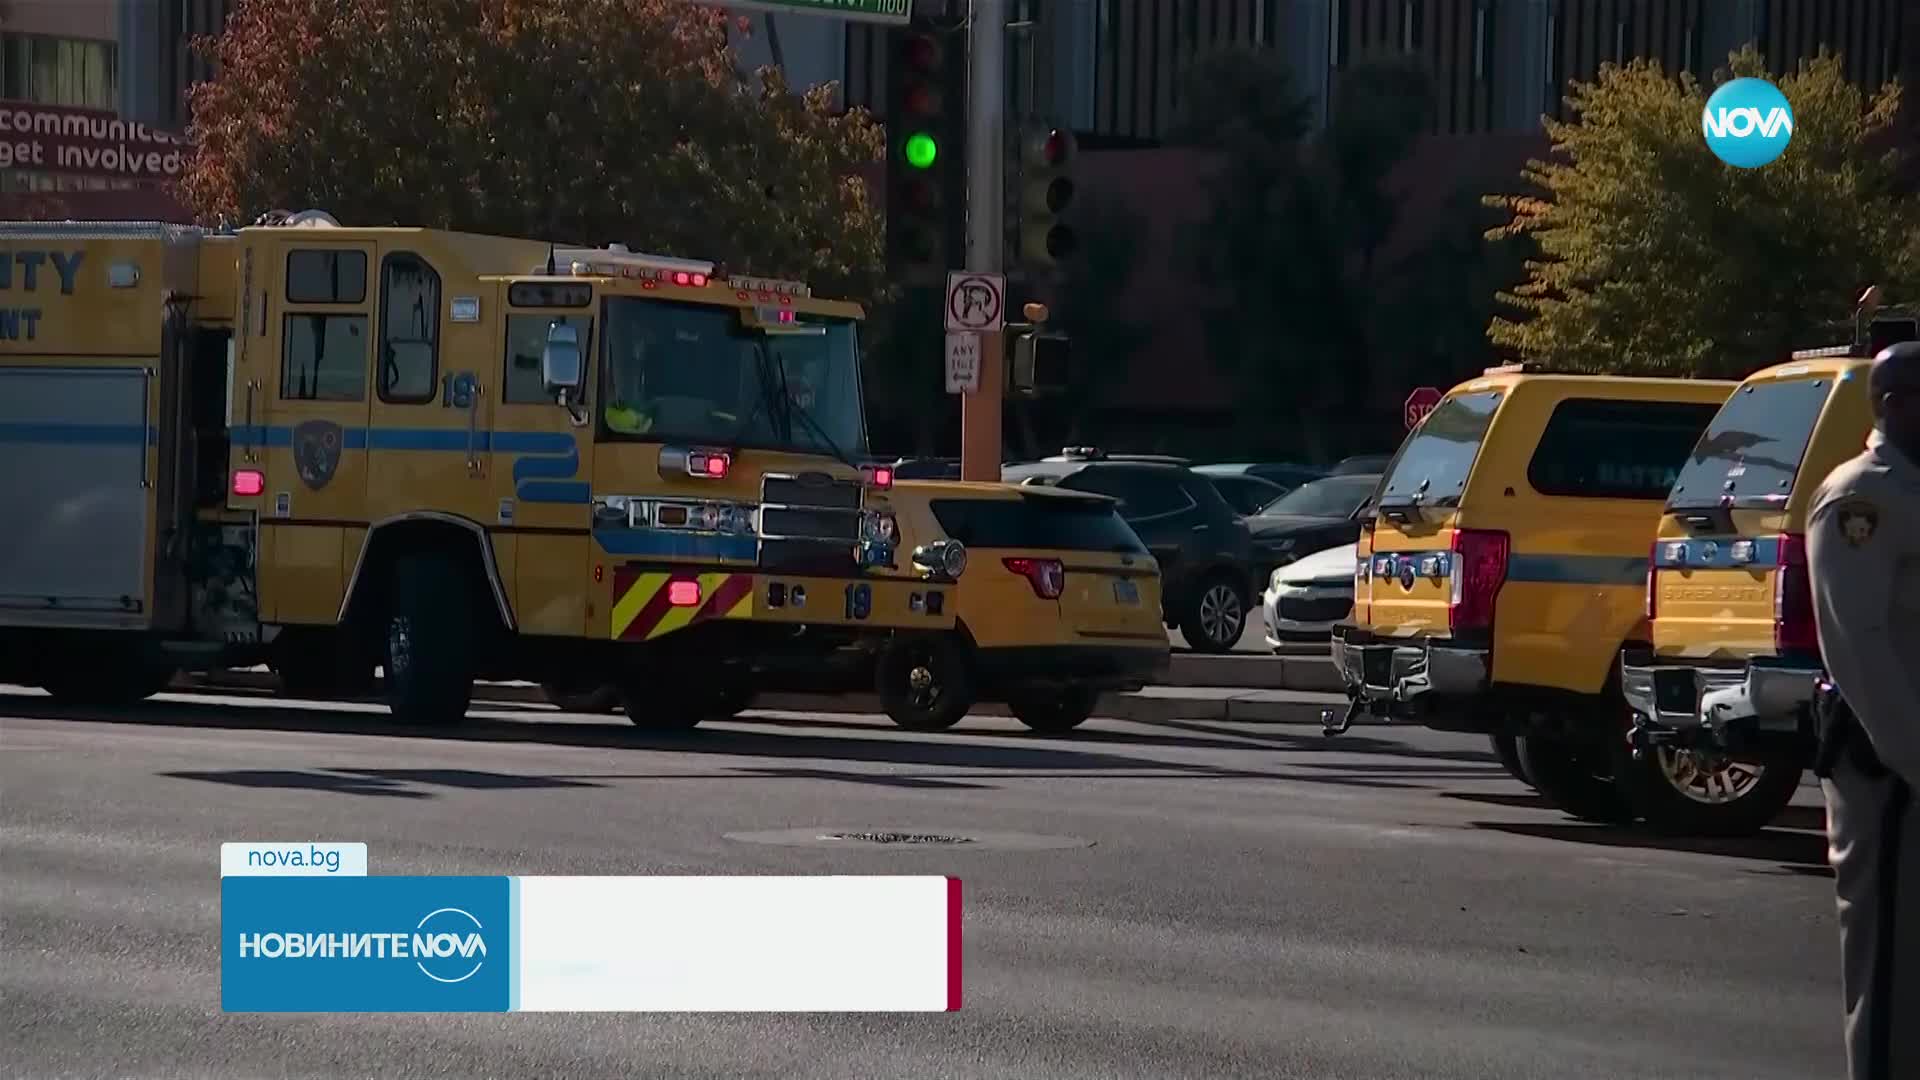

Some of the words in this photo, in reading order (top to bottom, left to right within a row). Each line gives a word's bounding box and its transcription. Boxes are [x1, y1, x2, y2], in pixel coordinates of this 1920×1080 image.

[0, 141, 44, 168] get
[57, 144, 181, 175] involved
[952, 344, 974, 356] ANY
[845, 582, 872, 619] 19
[1664, 584, 1713, 600] SUPER
[1719, 585, 1768, 602] DUTY
